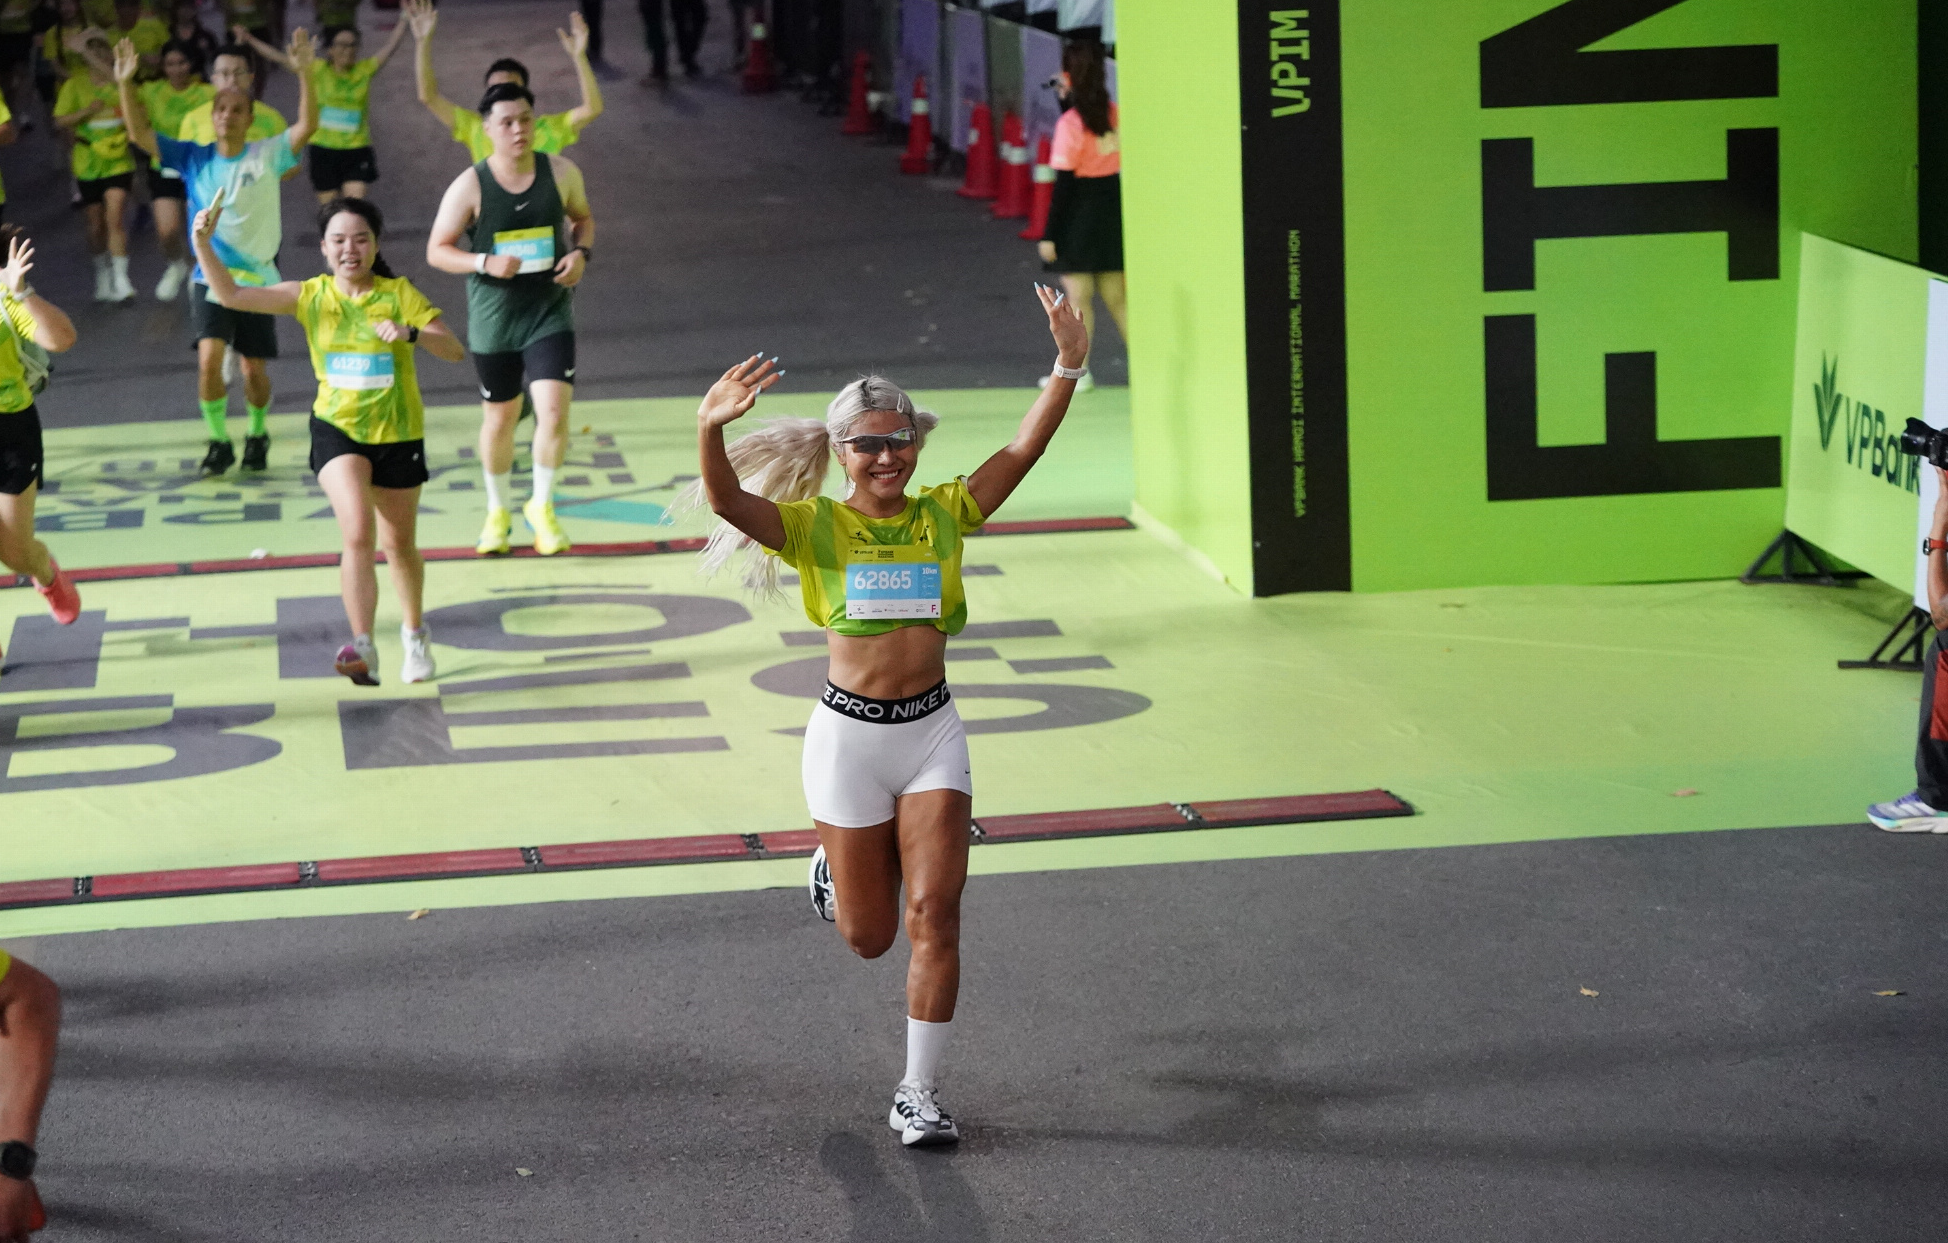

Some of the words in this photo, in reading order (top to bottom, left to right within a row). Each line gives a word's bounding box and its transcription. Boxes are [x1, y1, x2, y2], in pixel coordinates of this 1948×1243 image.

[1269, 9, 1311, 118] VPIM
[1287, 228, 1301, 300] MARATHON
[1288, 303, 1304, 415] INTERNATIONAL
[1291, 417, 1305, 463] HANOI
[854, 570, 912, 590] 62865
[931, 604, 937, 613] F
[831, 691, 885, 719] PRO
[890, 689, 940, 719] NIKE
